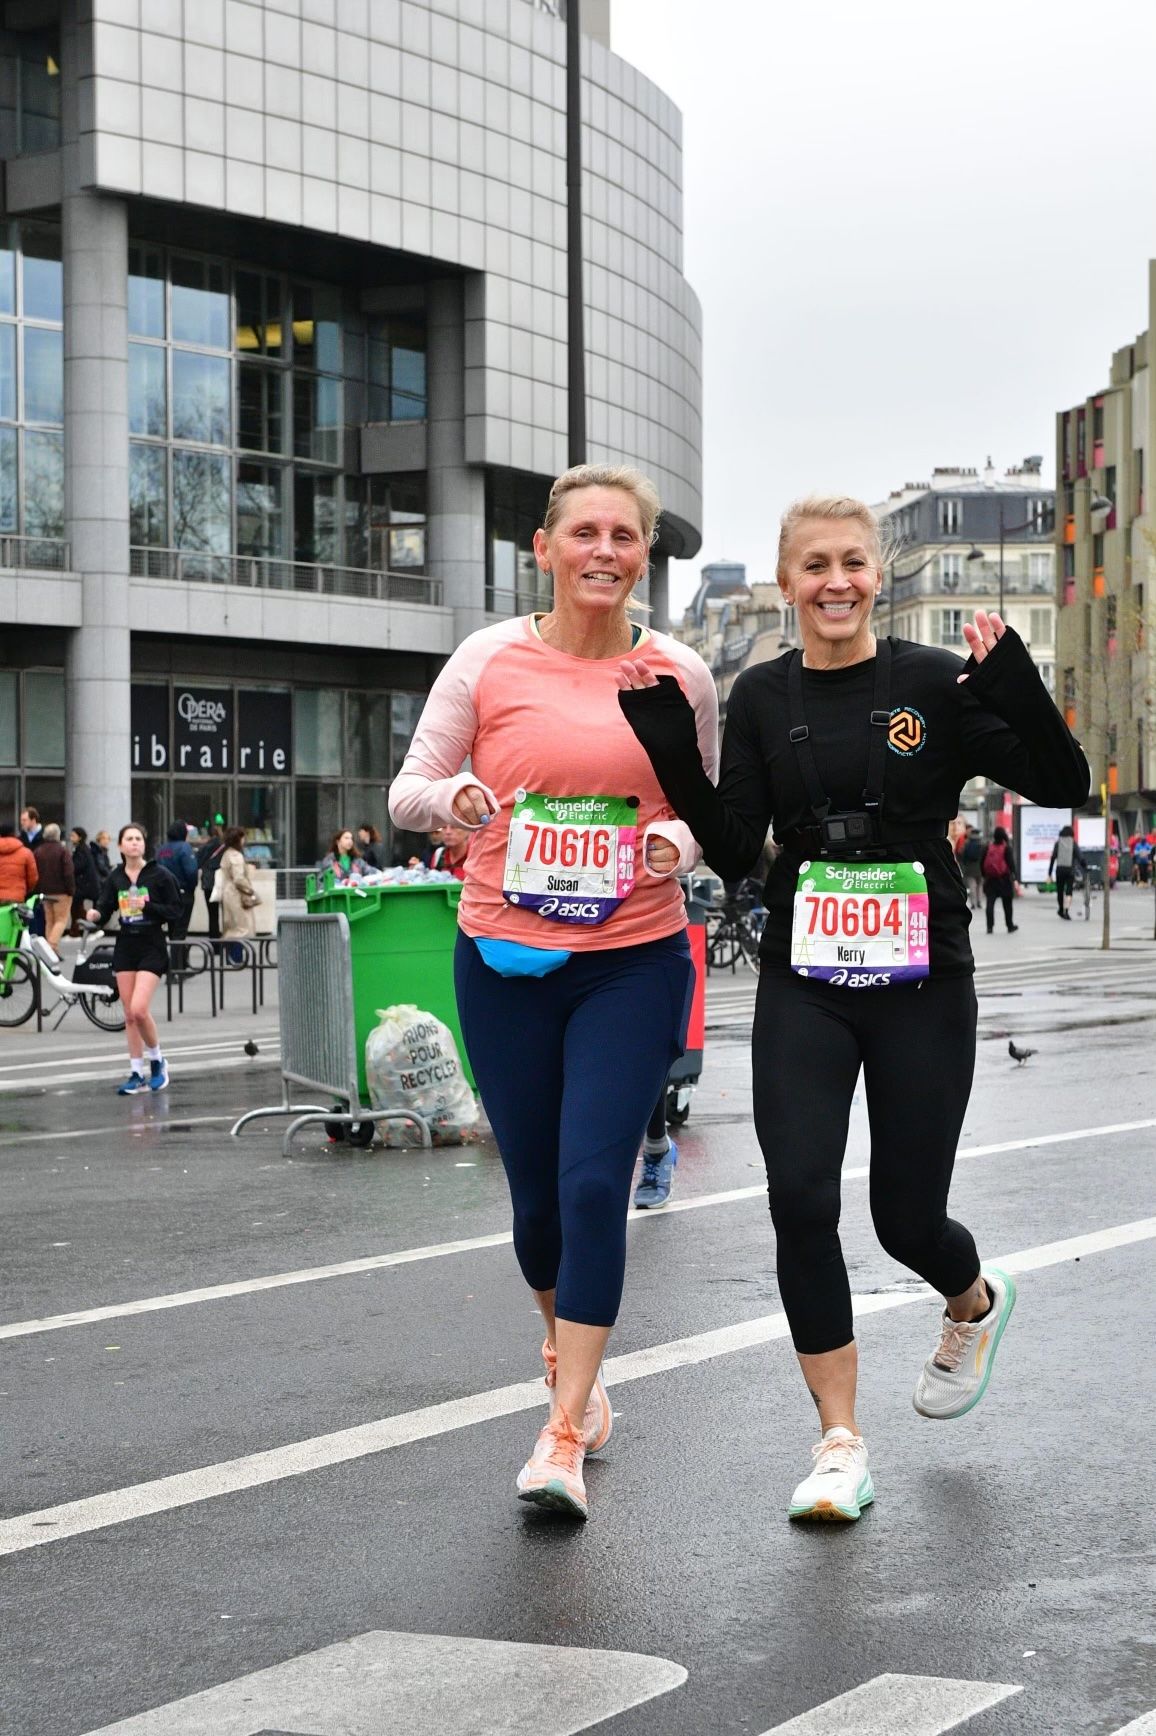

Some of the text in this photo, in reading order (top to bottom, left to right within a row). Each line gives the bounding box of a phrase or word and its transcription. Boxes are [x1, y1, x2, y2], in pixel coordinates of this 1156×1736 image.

[134, 734, 286, 770] ibrairie
[569, 813, 608, 821] Electric
[524, 824, 610, 869] 70616
[618, 844, 635, 862] 4h
[618, 862, 633, 880] 30
[825, 866, 896, 881] Schneider
[547, 875, 579, 892] Susan
[855, 881, 895, 889] Electric
[805, 896, 903, 937] 70604
[909, 912, 927, 929] 4h
[910, 930, 927, 947] 30
[837, 945, 866, 966] Kerry
[409, 1042, 443, 1064] POUR
